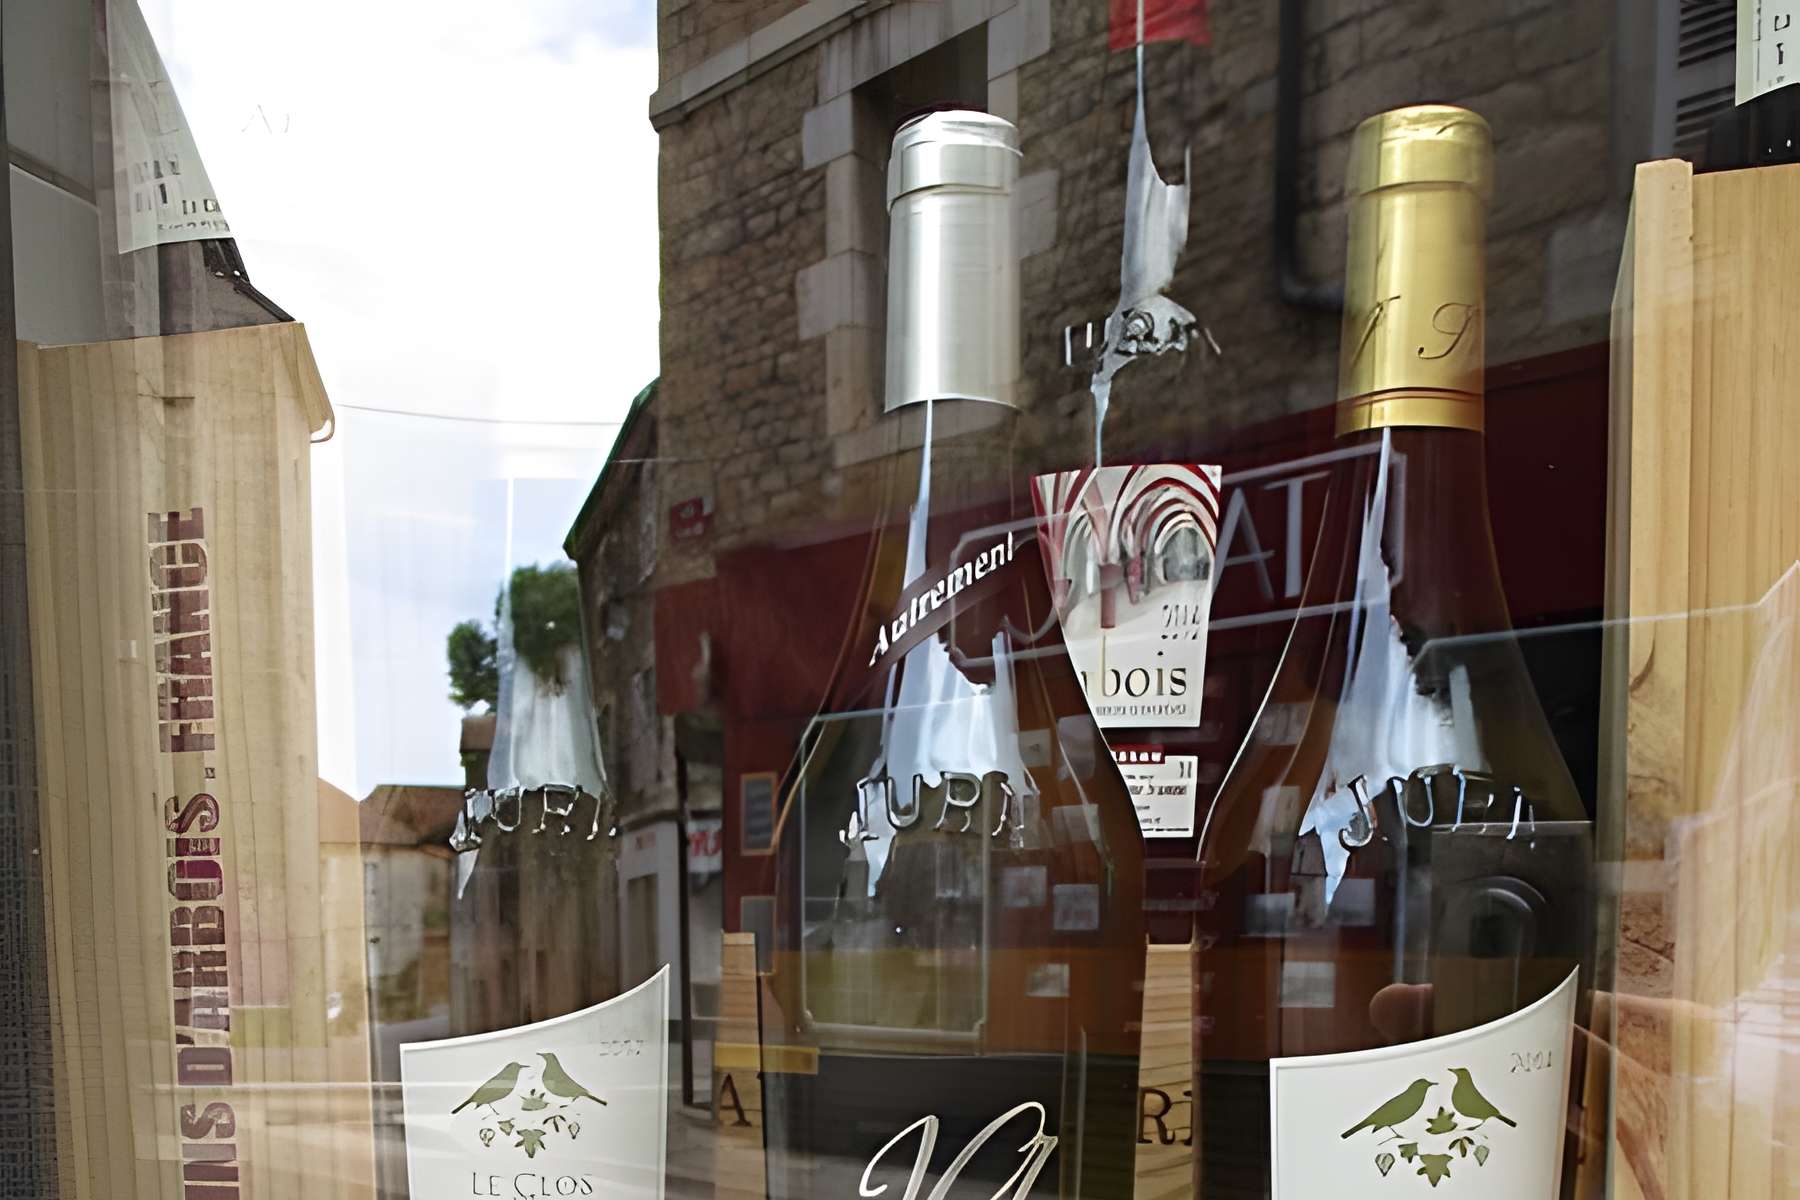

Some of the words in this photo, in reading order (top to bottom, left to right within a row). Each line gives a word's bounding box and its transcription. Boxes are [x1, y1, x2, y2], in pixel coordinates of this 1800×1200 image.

[146, 507, 216, 753] FRANCE
[164, 793, 233, 1087] D'ARBOIS
[472, 1172, 503, 1197] LE
[513, 1172, 594, 1200] CLOS
